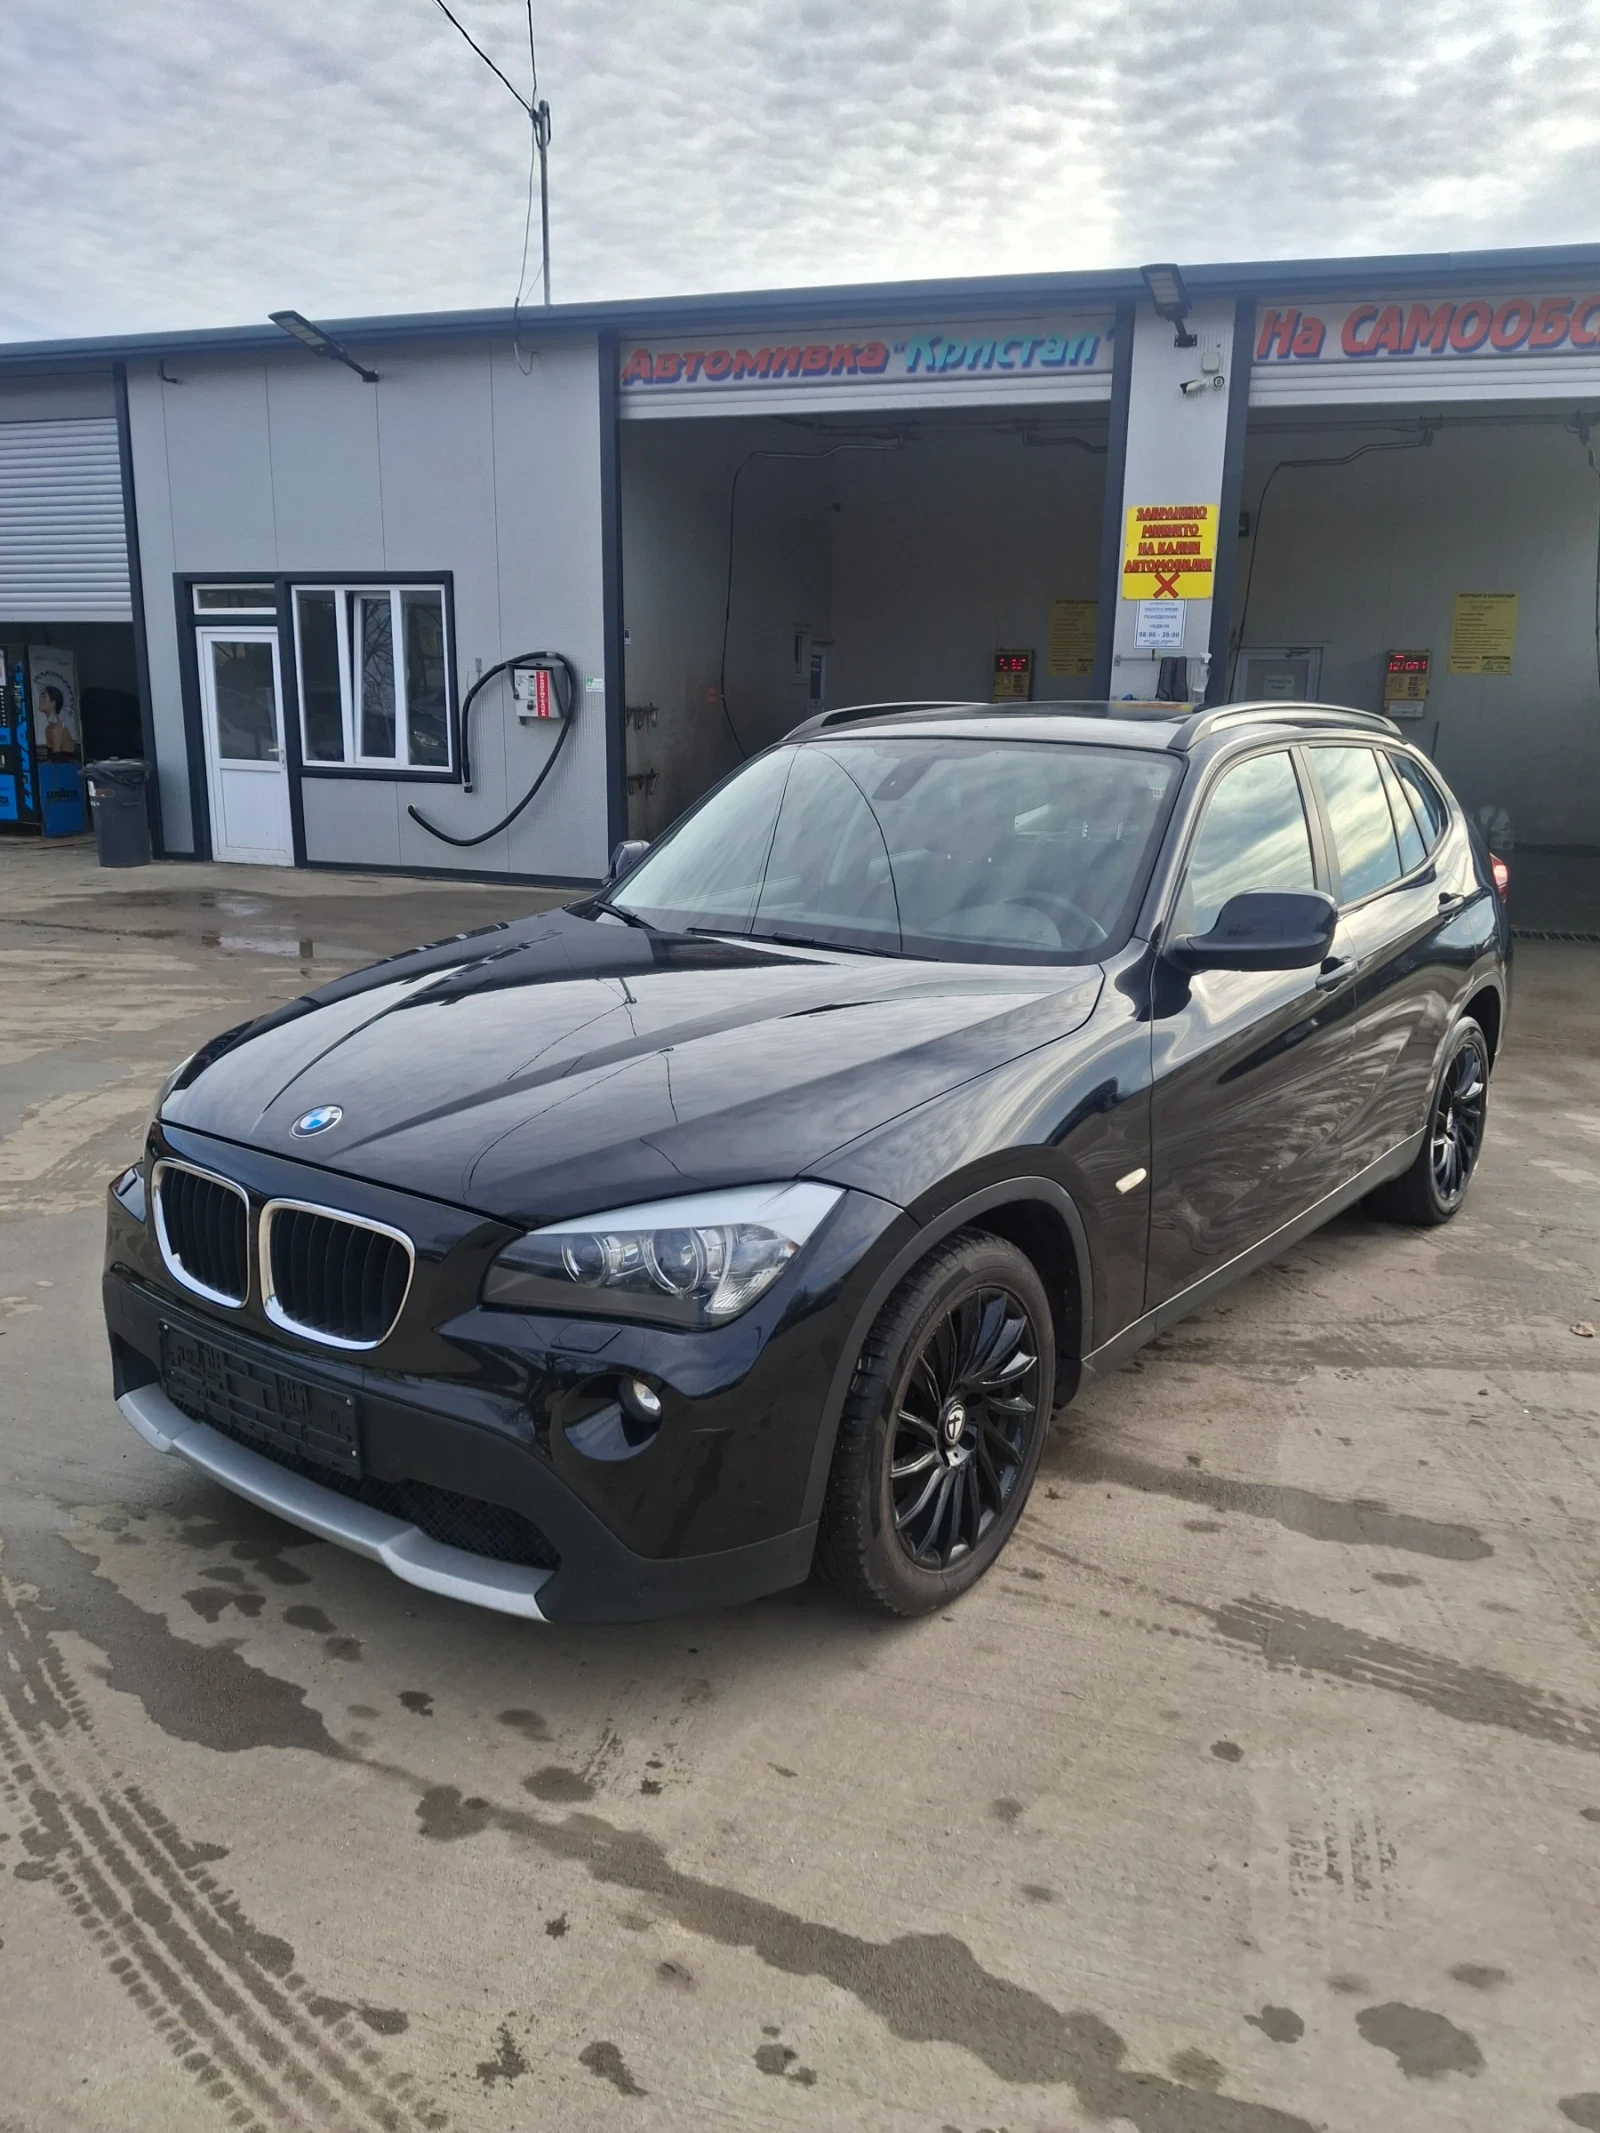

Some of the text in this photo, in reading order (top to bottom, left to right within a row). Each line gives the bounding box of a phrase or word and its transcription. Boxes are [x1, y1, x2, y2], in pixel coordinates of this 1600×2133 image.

[1256, 294, 1600, 359] На САМООБС
[1137, 505, 1207, 520] ЗАБРАНЕНО
[1142, 524, 1200, 538] МИЕНЕТО
[1138, 541, 1201, 555] НА КАЛНИ
